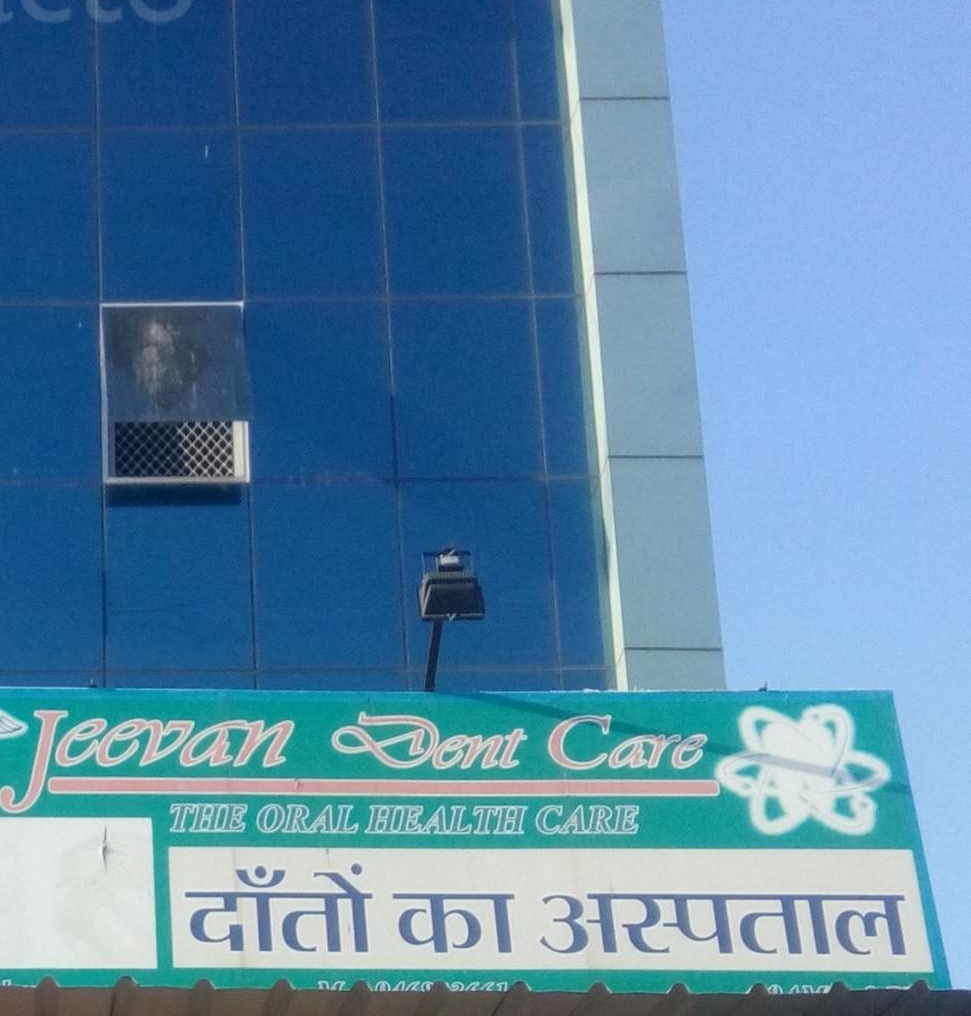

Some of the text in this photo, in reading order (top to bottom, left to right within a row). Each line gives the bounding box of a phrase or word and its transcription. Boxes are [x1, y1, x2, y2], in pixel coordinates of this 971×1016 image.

[331, 712, 528, 769] Dent
[548, 715, 708, 769] Care
[170, 803, 639, 835] THE ORAL HEALTH CARE
[185, 863, 905, 955] दाँतों का अस्पताल
